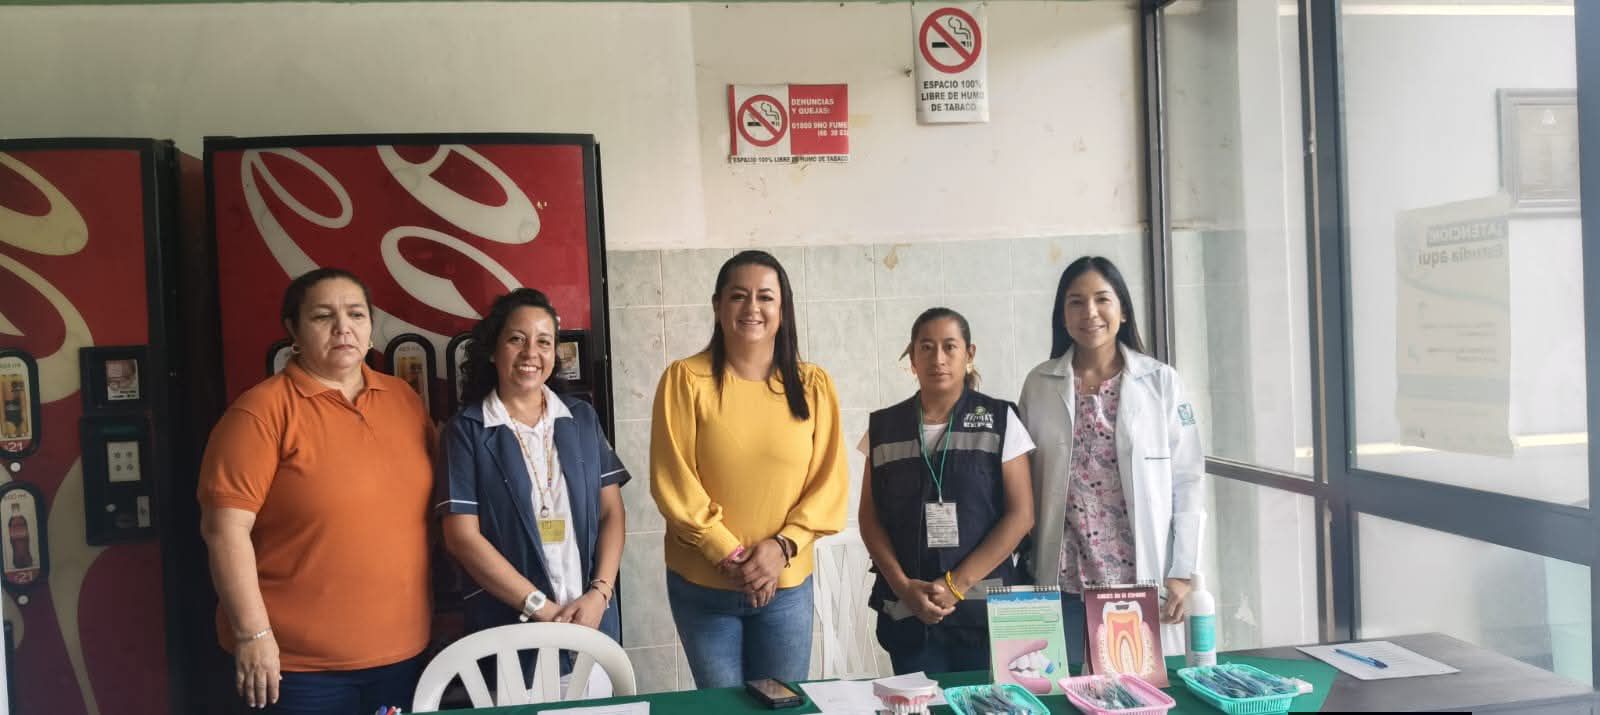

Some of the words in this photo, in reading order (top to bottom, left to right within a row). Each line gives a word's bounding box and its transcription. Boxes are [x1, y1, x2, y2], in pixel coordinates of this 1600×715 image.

[923, 80, 959, 89] ESPACIO
[961, 79, 984, 88] 100%
[921, 91, 945, 101] LIBRE
[947, 91, 959, 100] DE
[961, 91, 985, 100] HUMO
[791, 98, 834, 106] DENUNCIAS
[791, 106, 798, 114] Y
[931, 103, 942, 112] DE
[945, 103, 977, 112] TABACO
[818, 155, 826, 163] DE
[826, 154, 849, 162] TABACO
